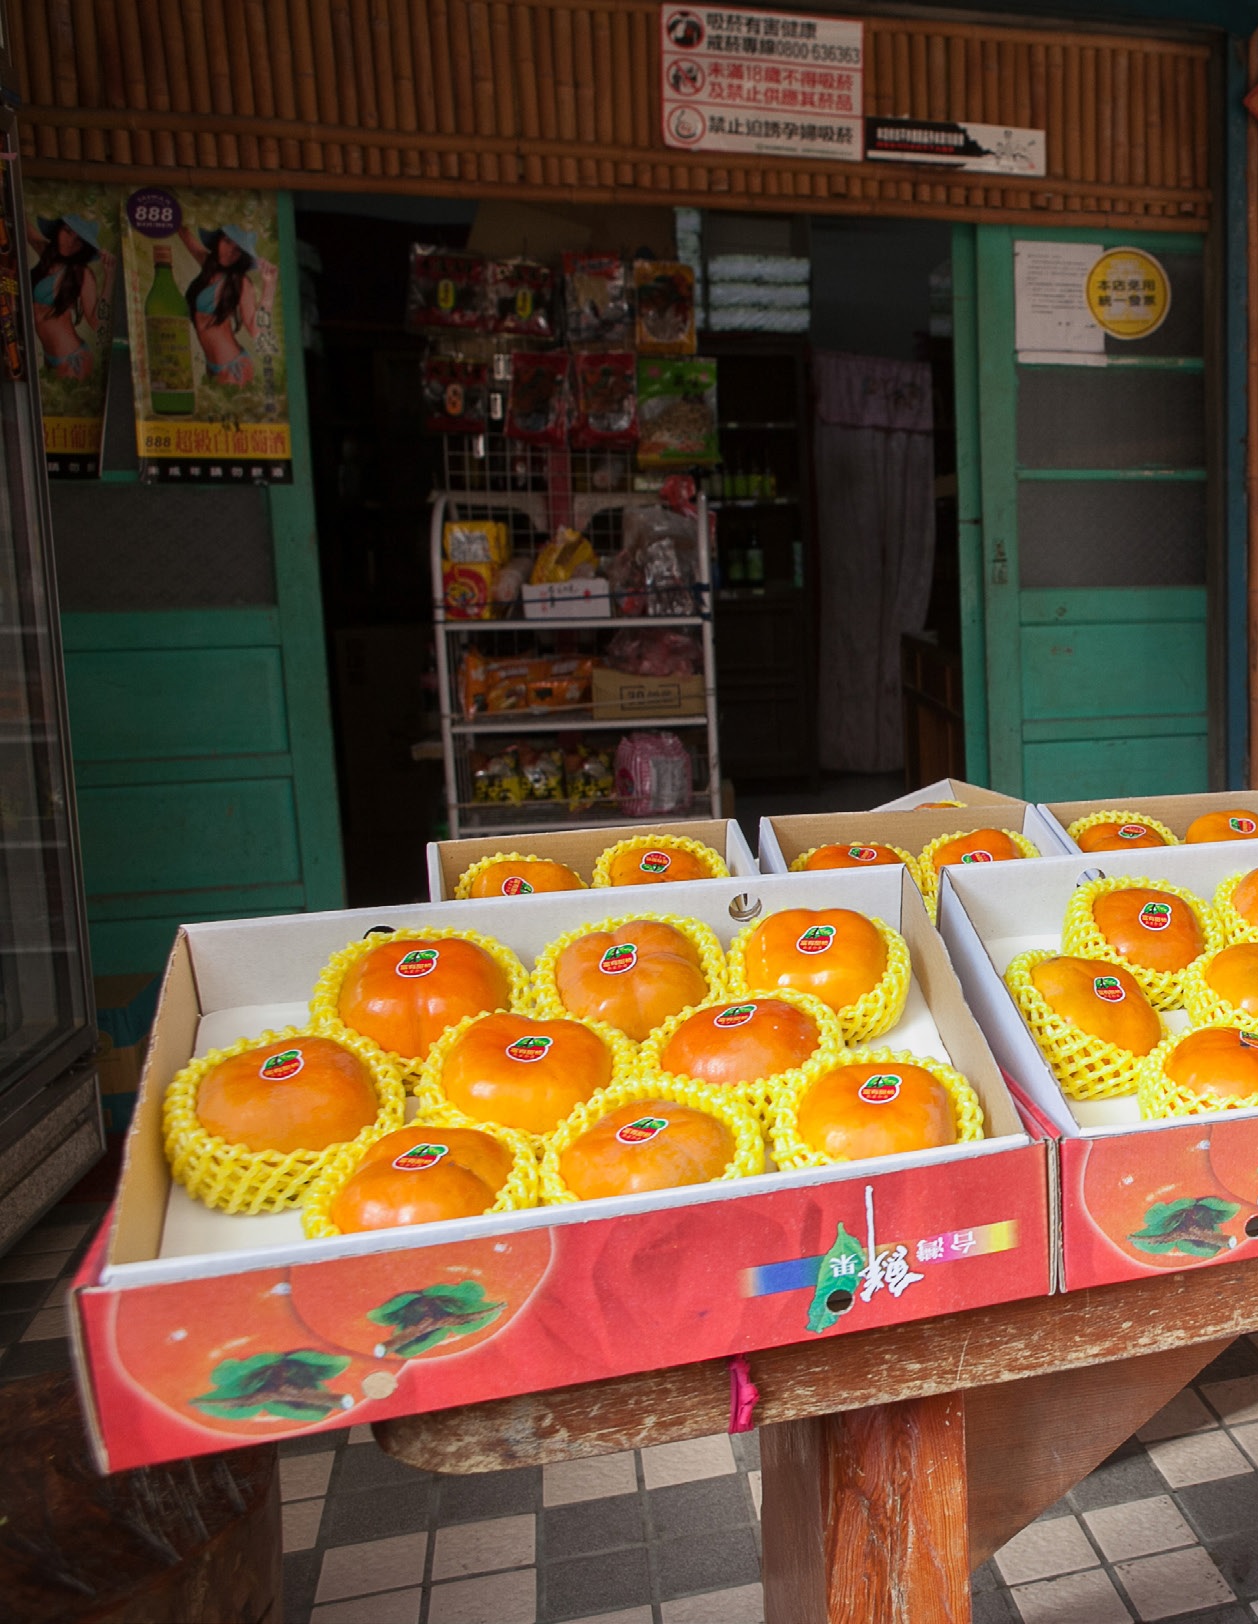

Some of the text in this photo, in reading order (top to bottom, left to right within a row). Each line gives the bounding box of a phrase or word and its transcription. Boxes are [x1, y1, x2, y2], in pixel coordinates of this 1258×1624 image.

[706, 12, 817, 39] 吸菸有害健康
[709, 61, 853, 91] 未滿18歲不得吸菸
[135, 205, 173, 222] 888
